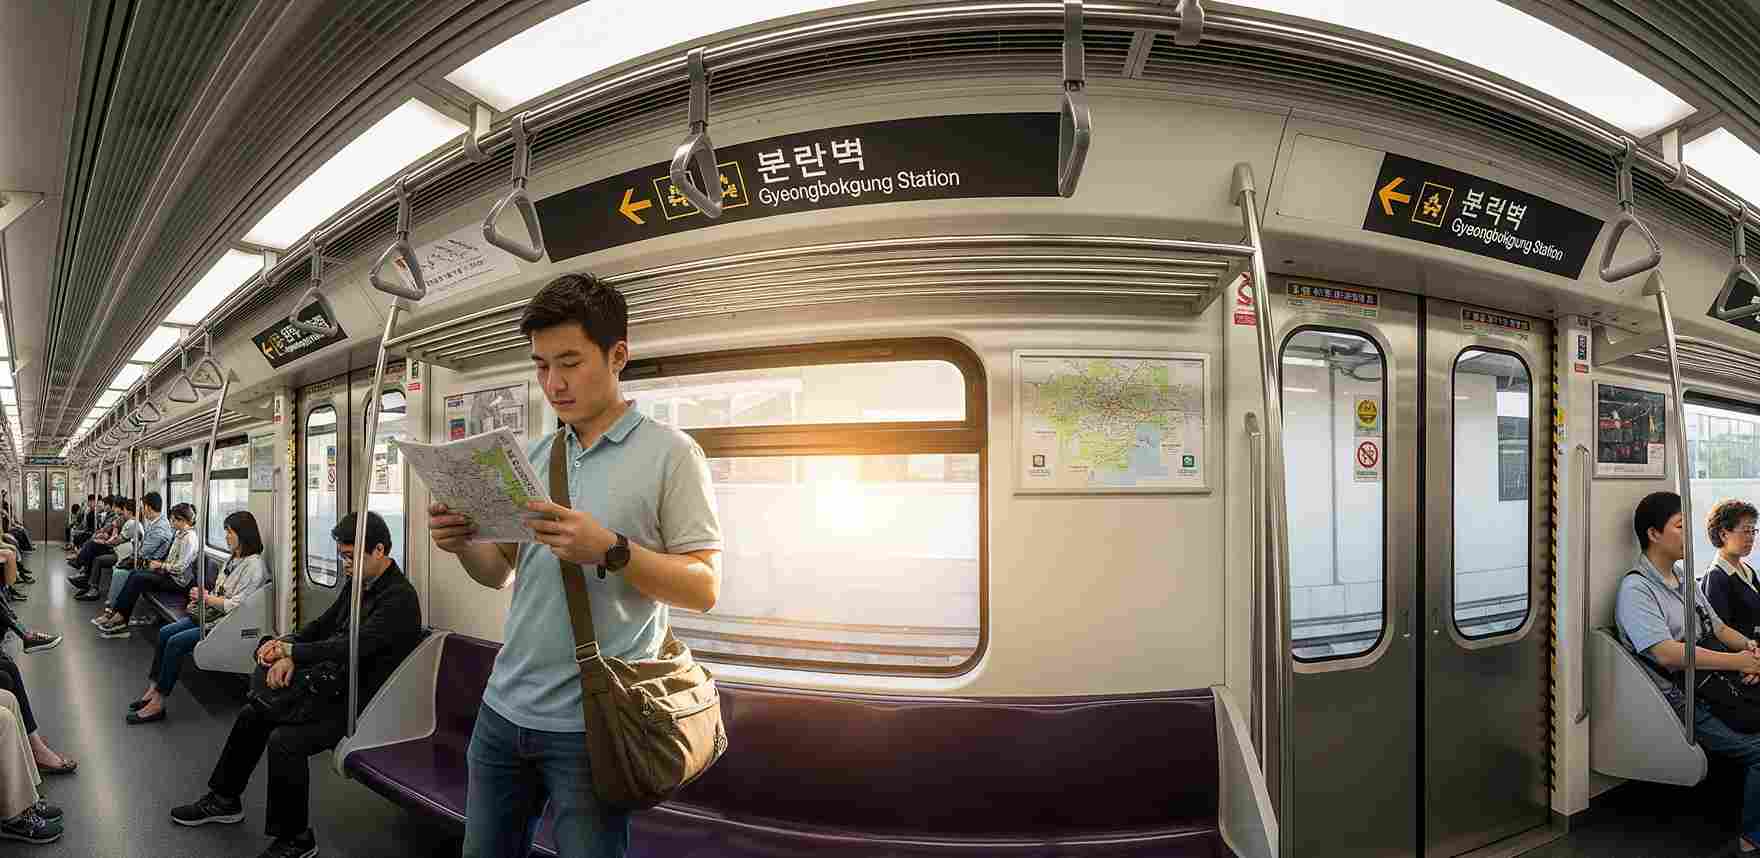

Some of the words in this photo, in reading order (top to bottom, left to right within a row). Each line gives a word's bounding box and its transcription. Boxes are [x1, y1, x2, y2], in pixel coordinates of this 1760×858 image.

[757, 137, 865, 184] 분란벽
[758, 175, 893, 207] Gyeongbokgung
[897, 169, 960, 189] Station
[1532, 240, 1563, 260] Station
